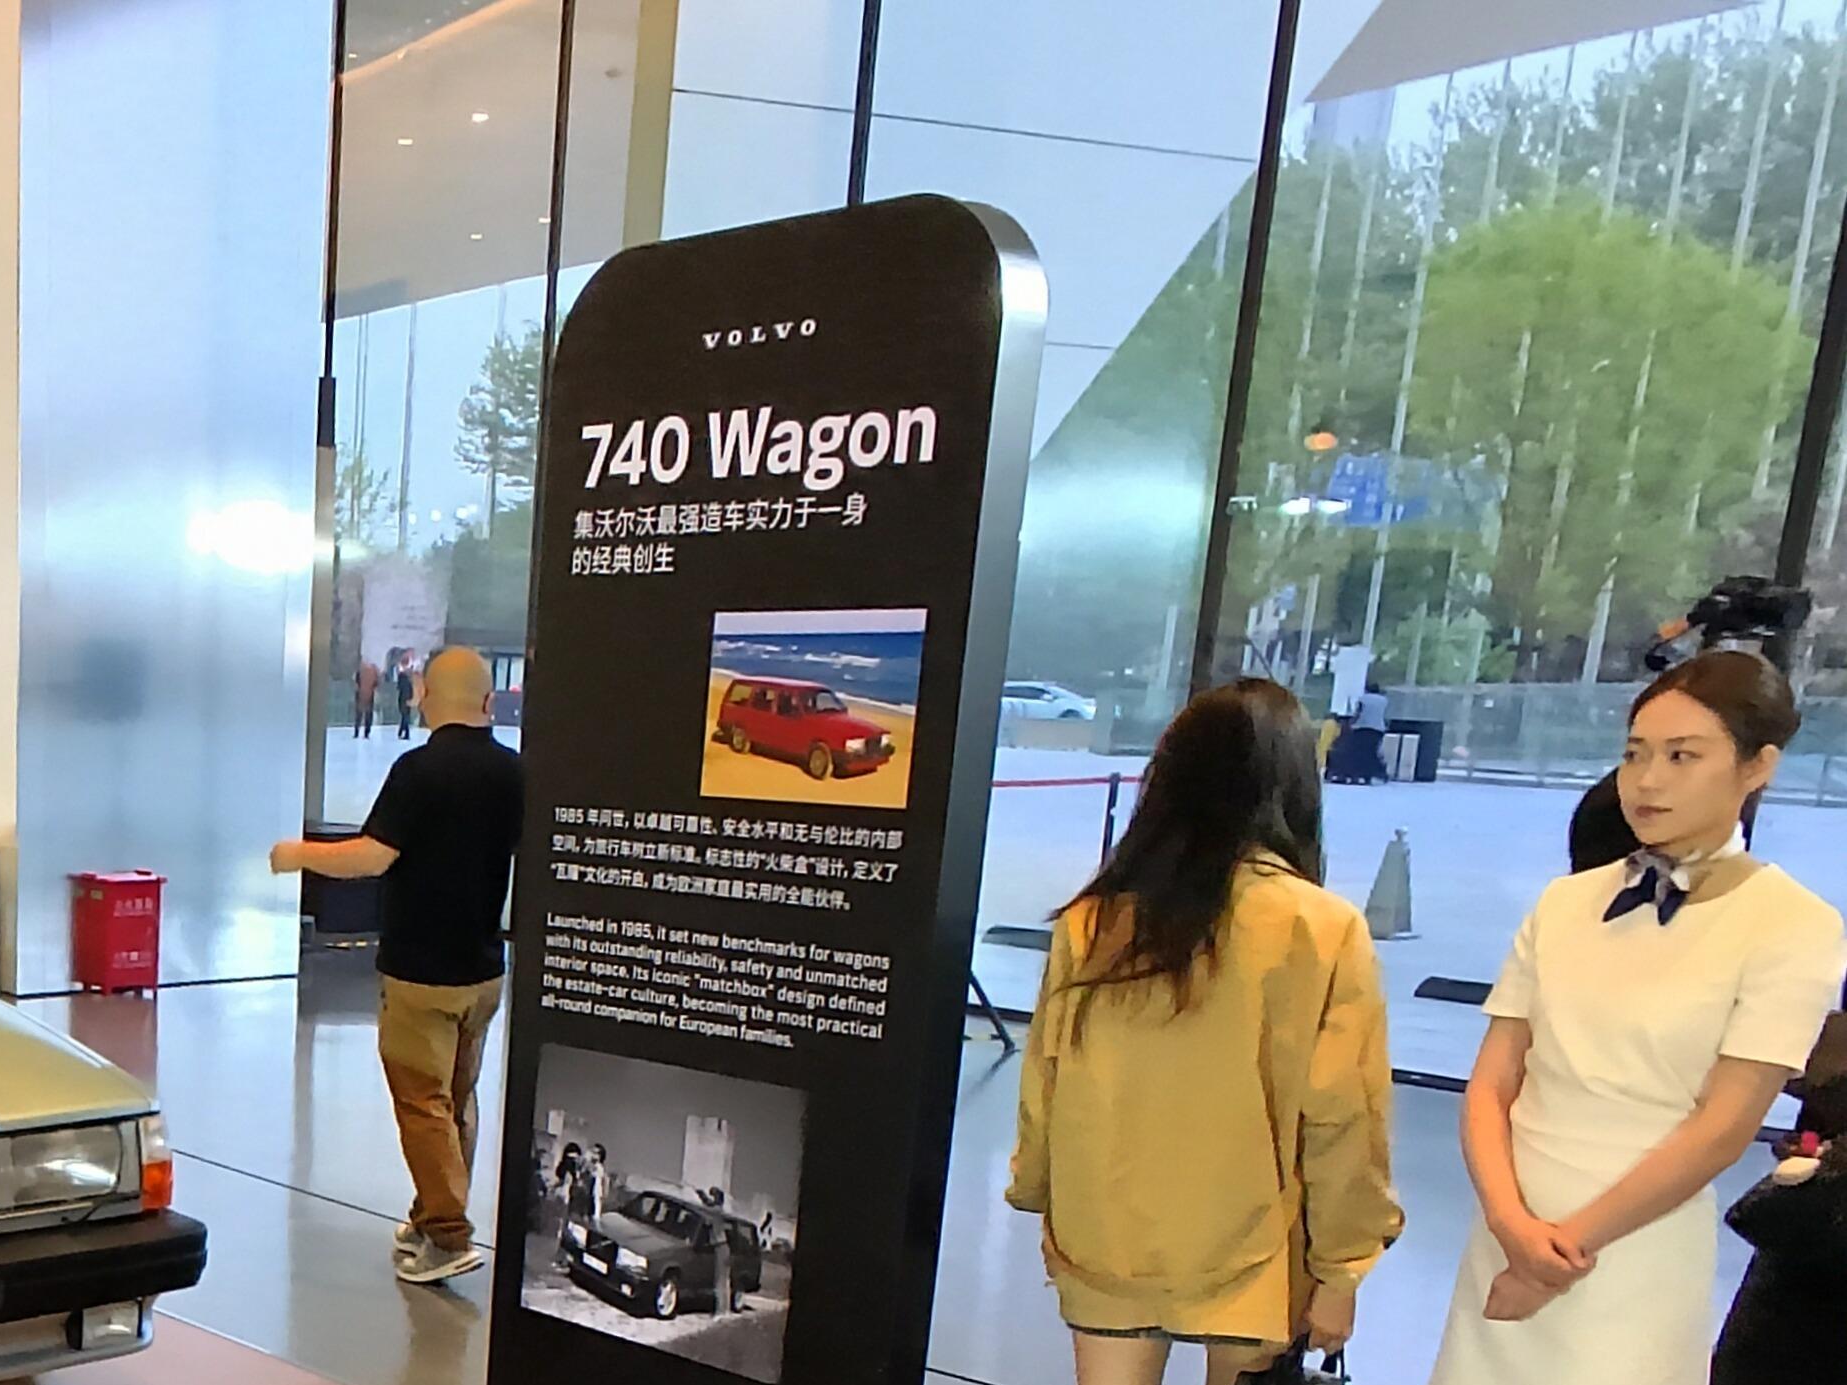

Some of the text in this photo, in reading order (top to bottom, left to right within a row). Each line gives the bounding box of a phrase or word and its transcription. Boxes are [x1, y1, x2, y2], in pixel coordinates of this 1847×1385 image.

[702, 318, 818, 350] VOLVO
[581, 404, 937, 492] 740 Wagon
[574, 493, 868, 539] 集沃尔沃最强造车实力于一身
[572, 543, 675, 577] 的经典创生
[546, 933, 570, 948] with
[573, 936, 587, 951] its
[589, 940, 662, 965] outstanding
[731, 957, 774, 980] safety
[776, 965, 803, 981] and
[806, 970, 888, 993] unmatched
[547, 912, 603, 932] Launched
[606, 918, 618, 934] in
[657, 925, 666, 940] it
[669, 928, 689, 944] set
[692, 931, 720, 947] new
[722, 933, 806, 958] benchmarks
[809, 944, 830, 961] for
[833, 950, 890, 970] wagons
[543, 973, 883, 1039] the estate-car culture, becoming the most practical
[544, 952, 588, 971] interior
[590, 960, 629, 979] space.
[632, 966, 649, 981] Its
[653, 968, 690, 987] iconic
[777, 986, 825, 1010] design
[828, 993, 886, 1016] defined
[541, 993, 794, 1048] all-round companion for European families.
